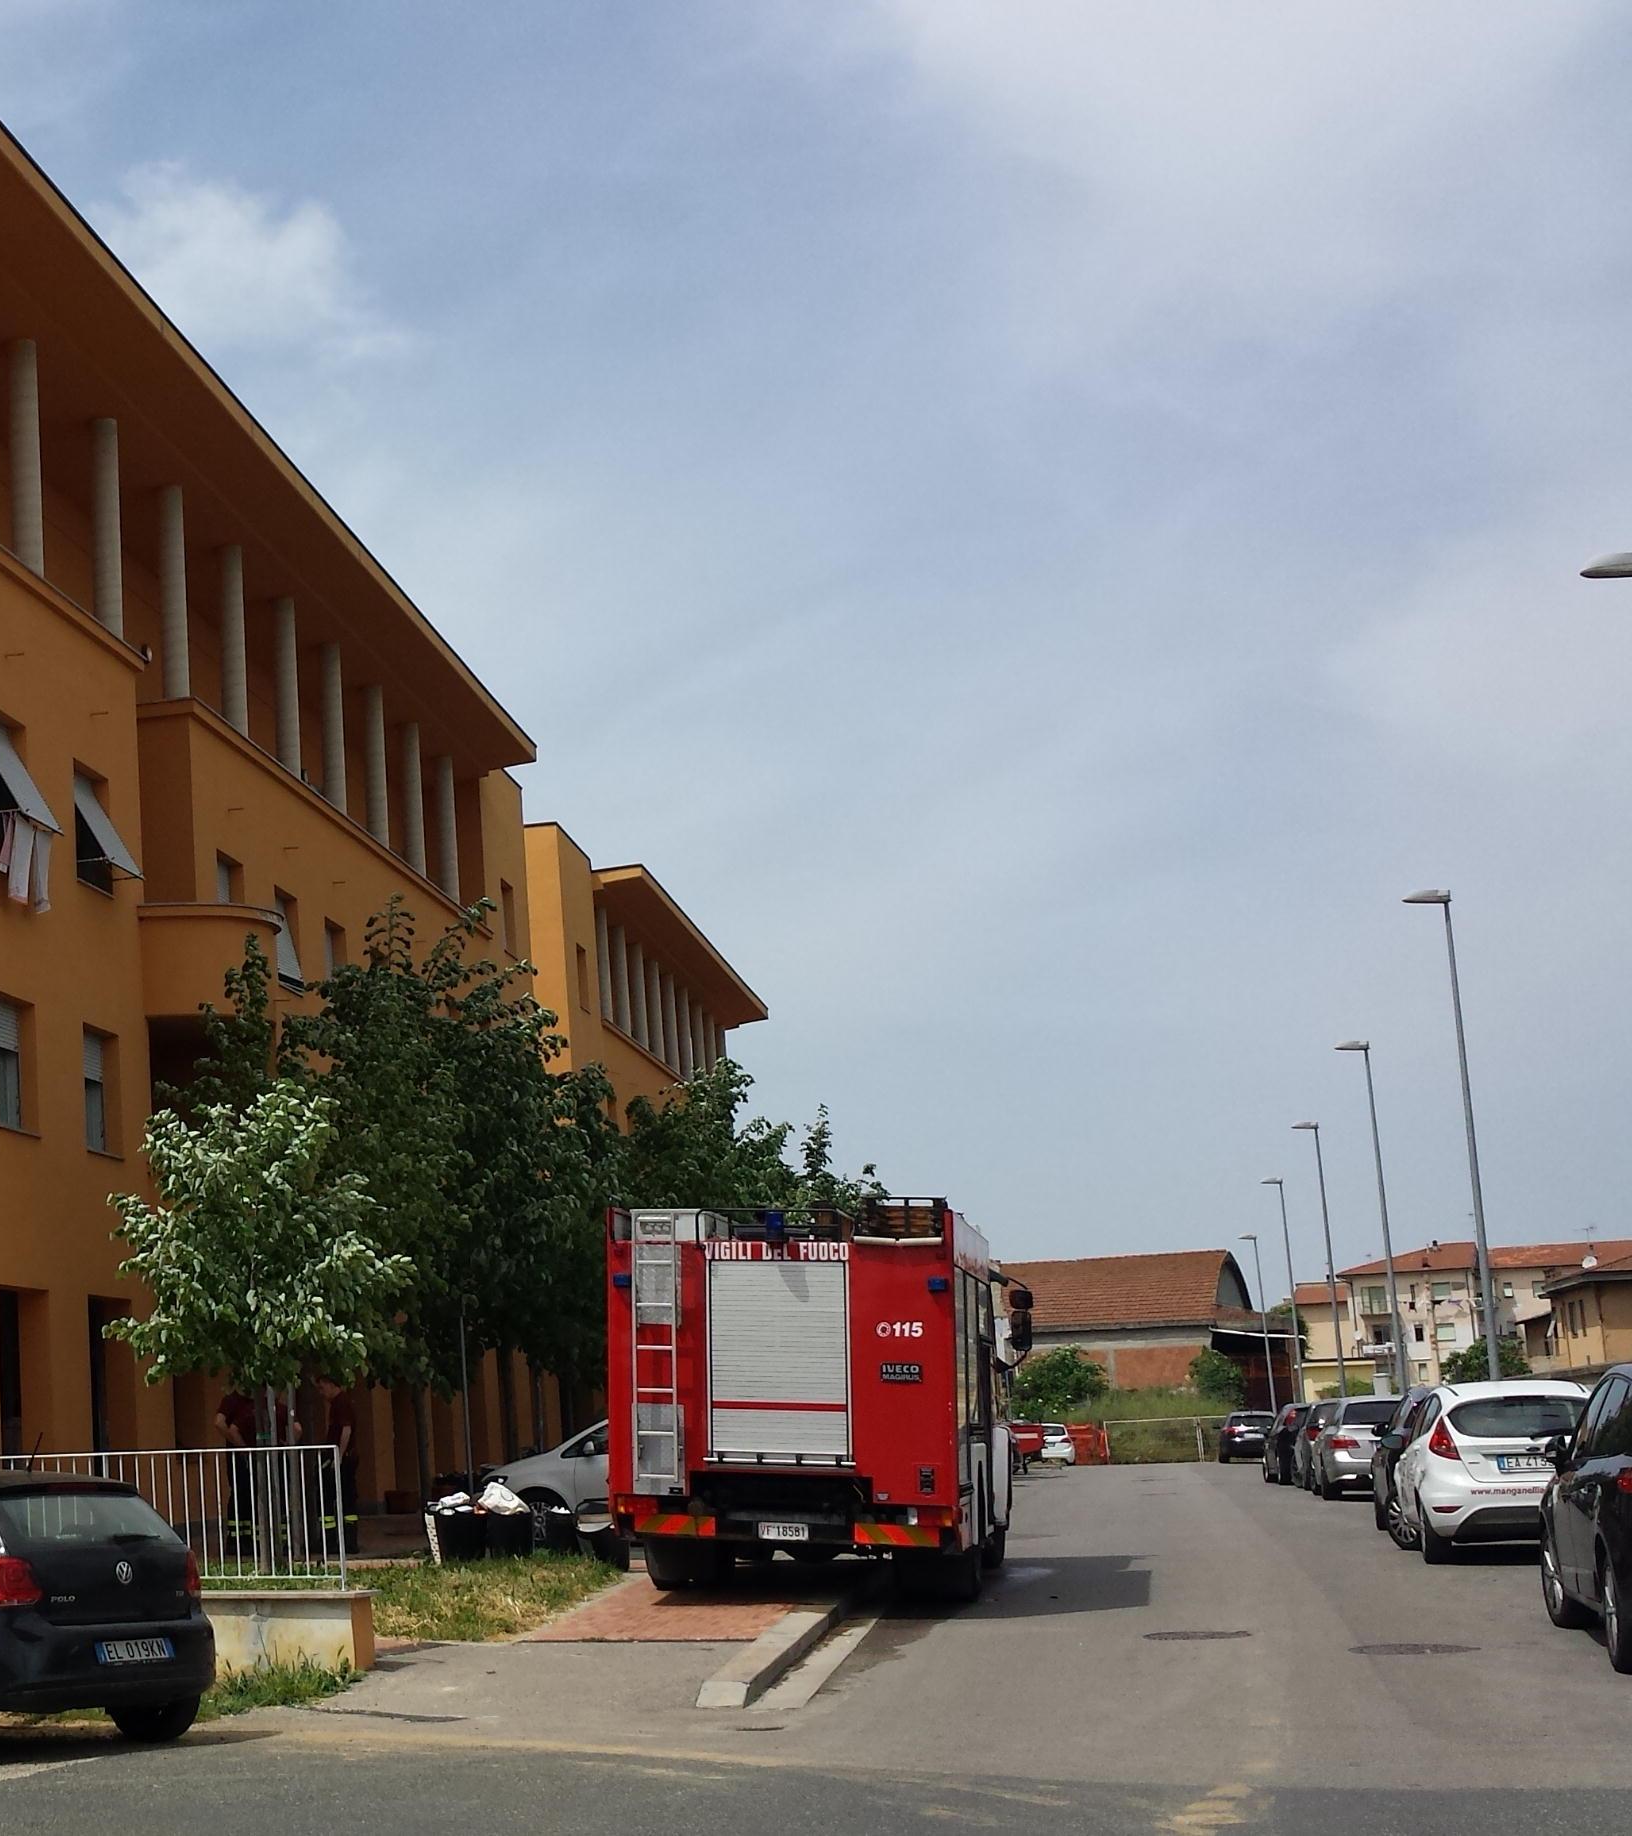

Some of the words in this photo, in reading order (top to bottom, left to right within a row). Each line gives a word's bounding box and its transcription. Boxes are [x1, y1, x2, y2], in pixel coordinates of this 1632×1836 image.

[704, 1241, 752, 1260] VIGILI
[761, 1241, 792, 1260] DEL
[799, 1241, 849, 1260] FUOCO
[892, 1321, 924, 1338] 115
[881, 1364, 920, 1374] IVECO
[881, 1373, 920, 1381] MAGIRUS
[50, 1595, 76, 1603] POLO
[105, 1643, 123, 1660] EL
[126, 1639, 166, 1658] 019KN
